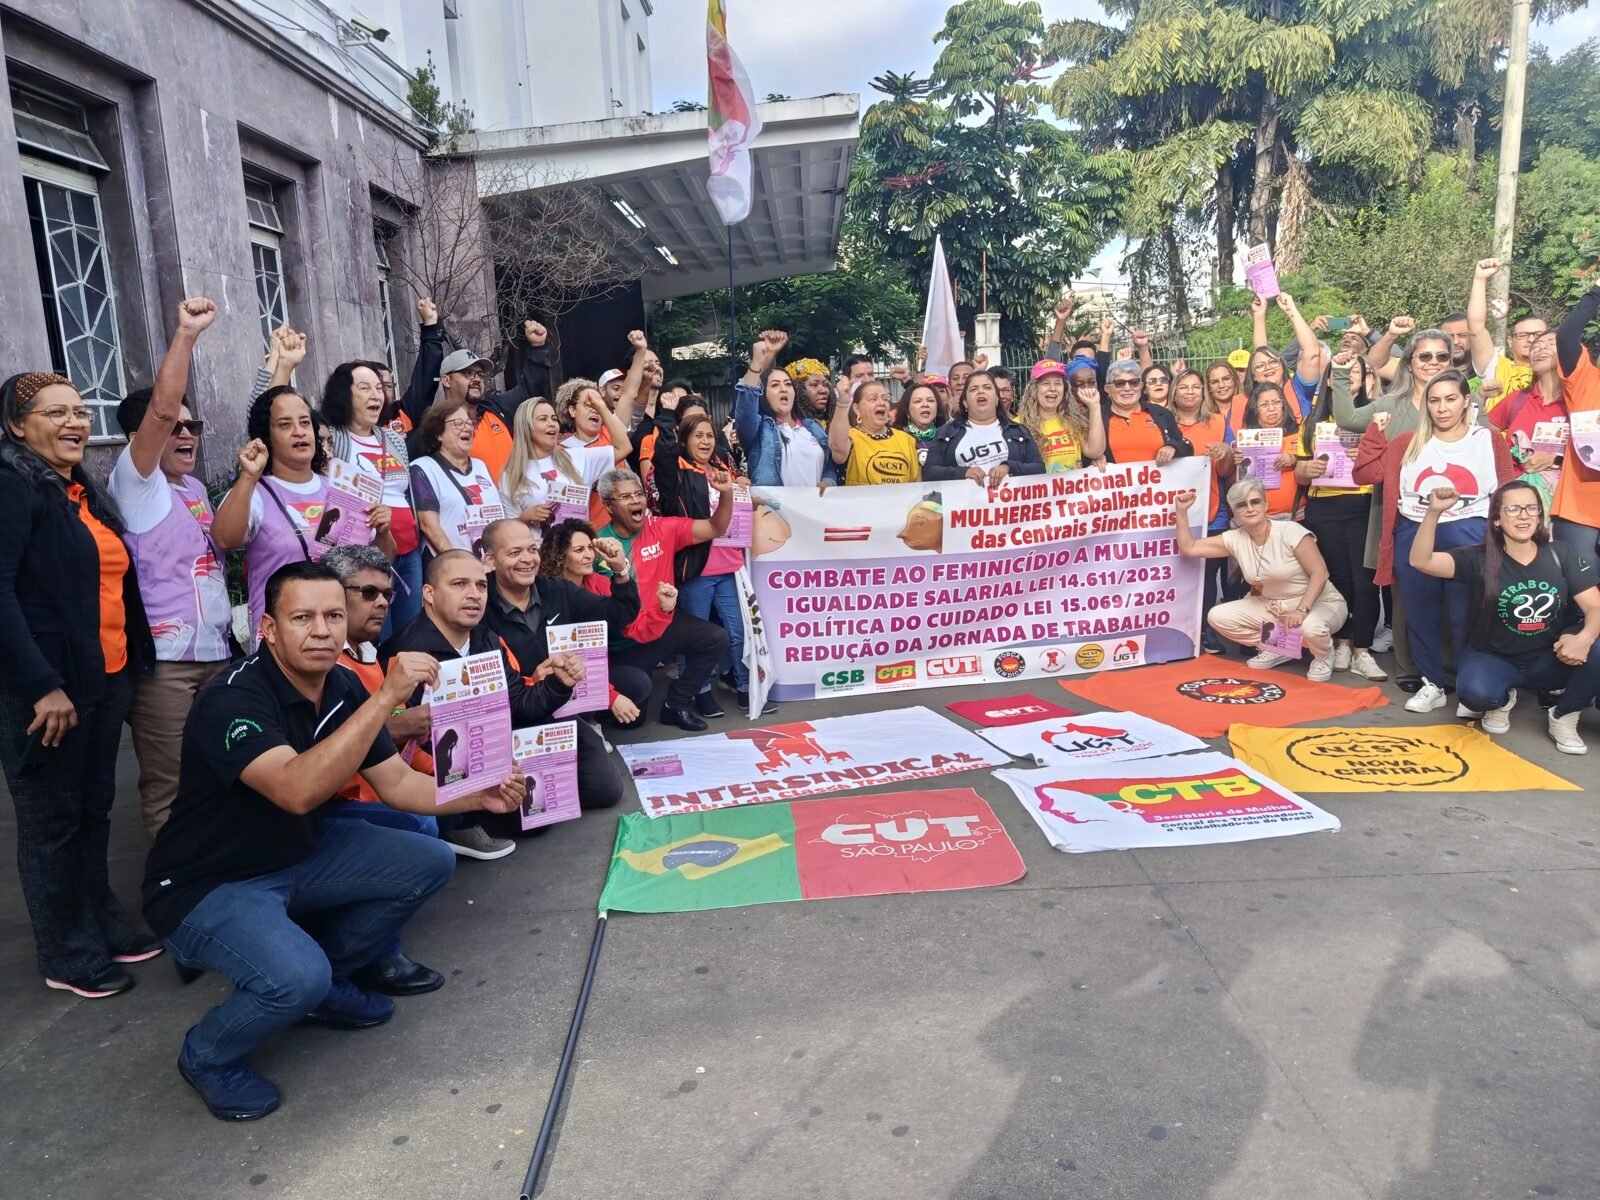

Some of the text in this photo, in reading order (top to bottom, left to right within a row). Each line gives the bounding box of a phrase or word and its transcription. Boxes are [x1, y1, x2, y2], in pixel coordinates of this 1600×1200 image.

[1044, 434, 1070, 447] TB
[960, 441, 1002, 463] UGT
[879, 462, 903, 471] NCST
[987, 465, 1162, 504] Fórum Nacional de
[1418, 494, 1476, 508] UT
[950, 501, 1052, 529] MULHERES
[971, 508, 1177, 550] das Centrais Sindicais
[641, 541, 660, 557] CUT
[768, 567, 886, 589] COMBATE
[891, 565, 926, 585] AO
[932, 550, 1070, 582] FEMINICÍDIO
[1073, 547, 1089, 564] A
[787, 566, 1172, 614] IGUALDADE SALARIAL LEI 14.611/2023
[1497, 580, 1558, 618] SINTRABOR
[779, 588, 1176, 639] POLÍTICA DO CUIDADO LEI 15.069/2024
[1513, 593, 1554, 619] 82
[785, 610, 1170, 663] REDUÇÃO DA JORNADA DE TRABALHO
[927, 656, 977, 676] CUT
[1113, 652, 1139, 662] UGT
[469, 660, 501, 675] MULHERES
[877, 664, 914, 680] CTB
[995, 664, 1026, 678] SINDICAL
[821, 669, 865, 686] CSB
[1201, 684, 1283, 704] SINDICAL
[985, 706, 1036, 718] CUT
[1053, 733, 1137, 753] UGT
[1316, 744, 1411, 753] NCST
[1334, 766, 1455, 776] CENTRAL
[1346, 759, 1420, 767] NOVA
[646, 752, 984, 810] INTERSINDICAL
[1118, 775, 1262, 805] CTB
[1153, 809, 1223, 821] Secretaria
[1245, 804, 1294, 814] Mulher
[1161, 820, 1204, 828] Central
[1232, 811, 1313, 821] Trabalhadores
[821, 815, 980, 845] CUT
[1176, 820, 1260, 831] Trabalhadoras
[1280, 814, 1314, 822] Brasil
[840, 839, 978, 858] SÃO PAULO
